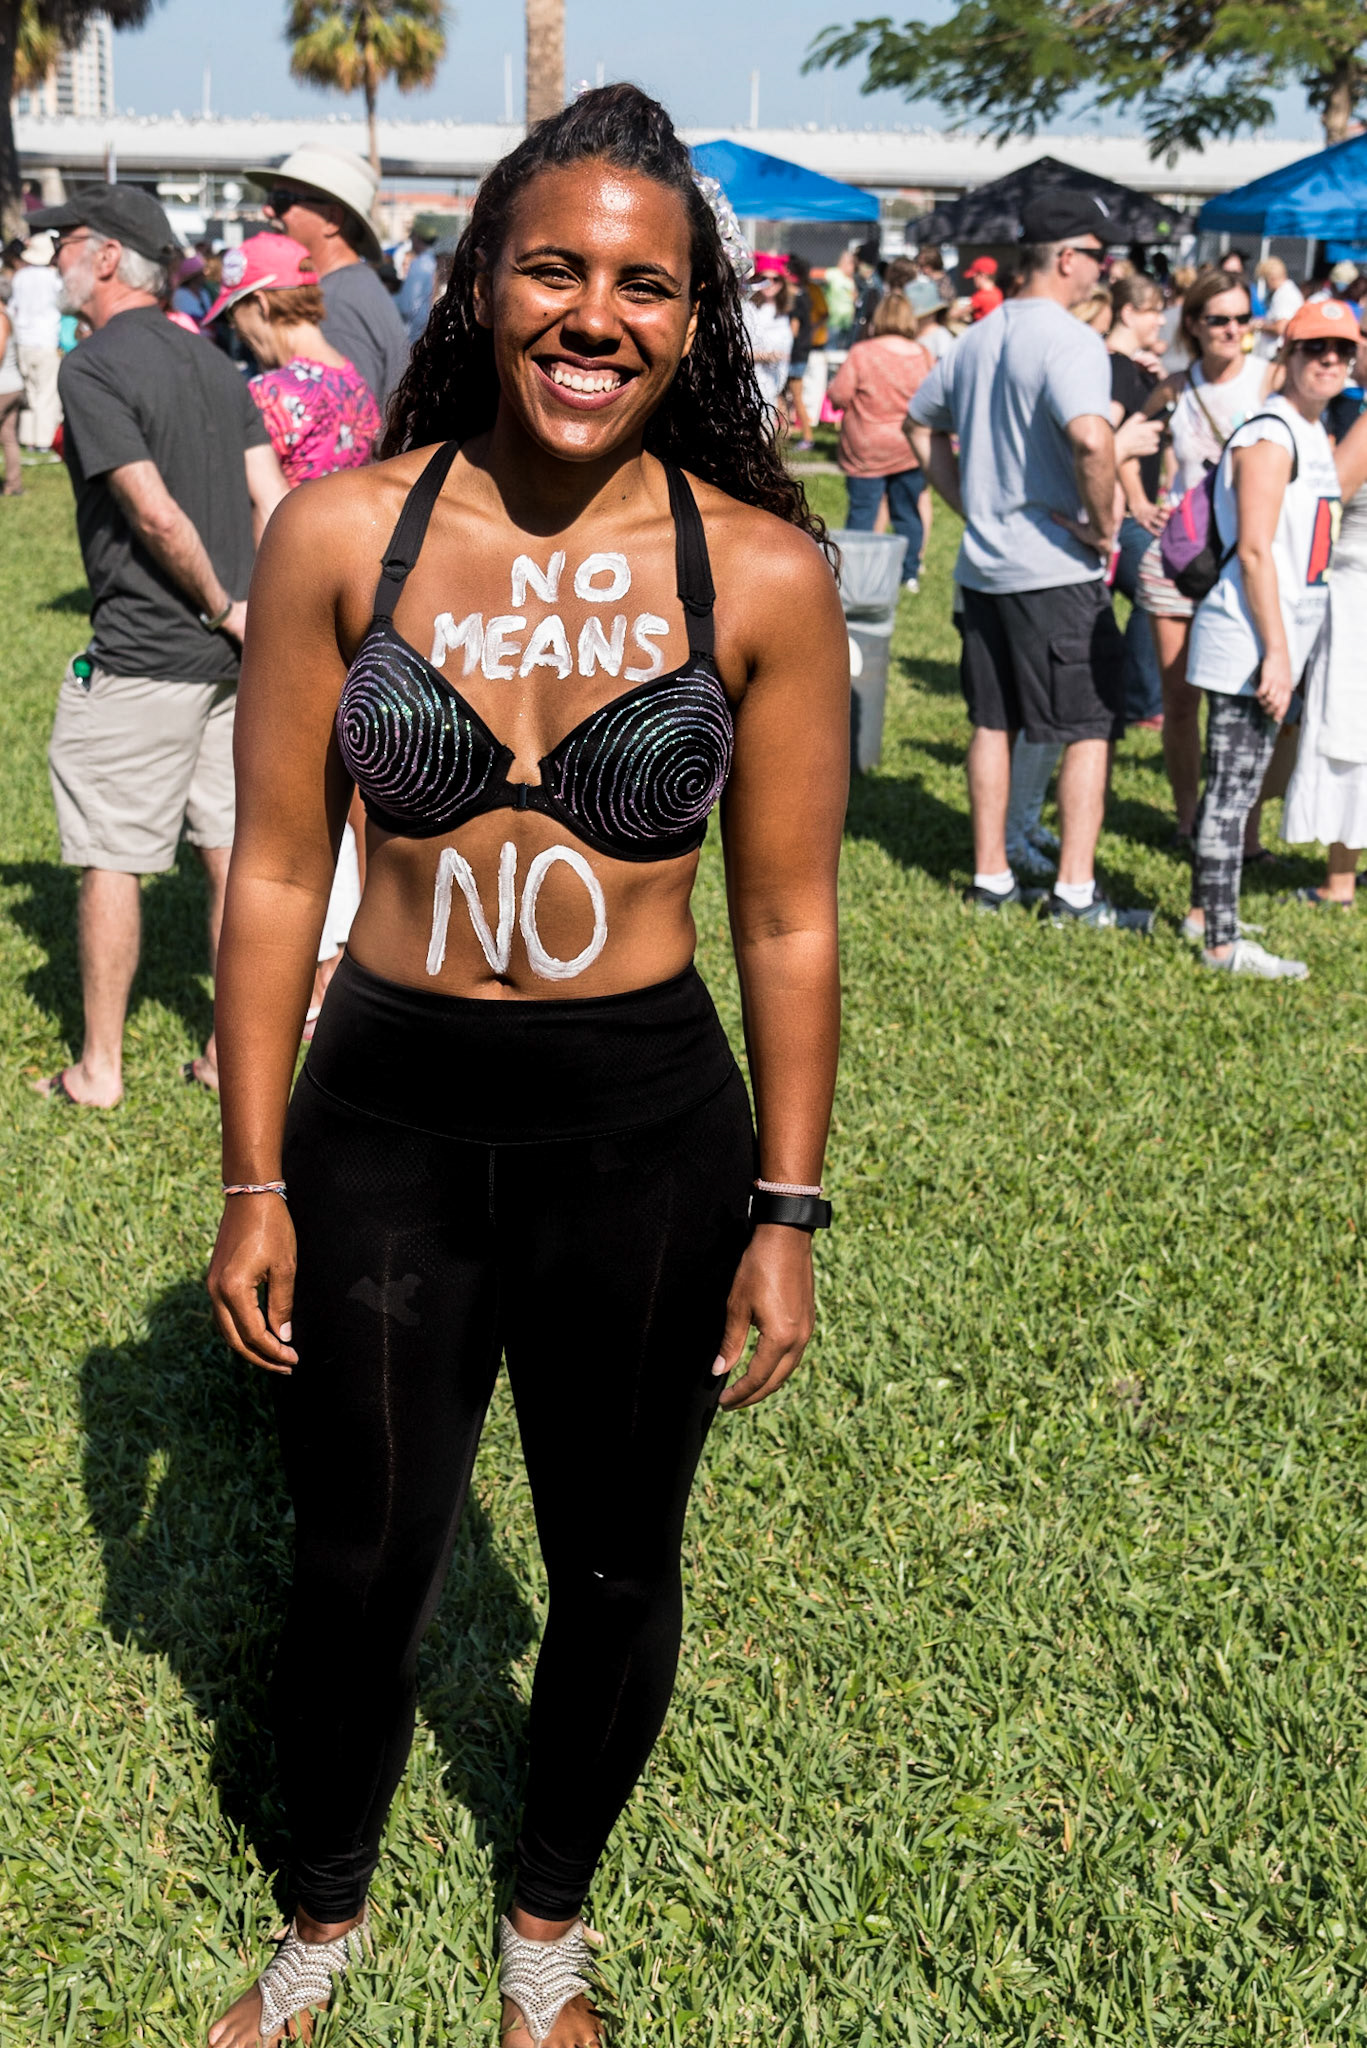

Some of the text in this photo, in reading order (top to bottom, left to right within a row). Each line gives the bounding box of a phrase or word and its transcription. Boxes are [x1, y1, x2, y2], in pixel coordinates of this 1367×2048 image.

[511, 550, 631, 607] NO
[430, 611, 670, 682] MEANS
[426, 841, 608, 981] NO
